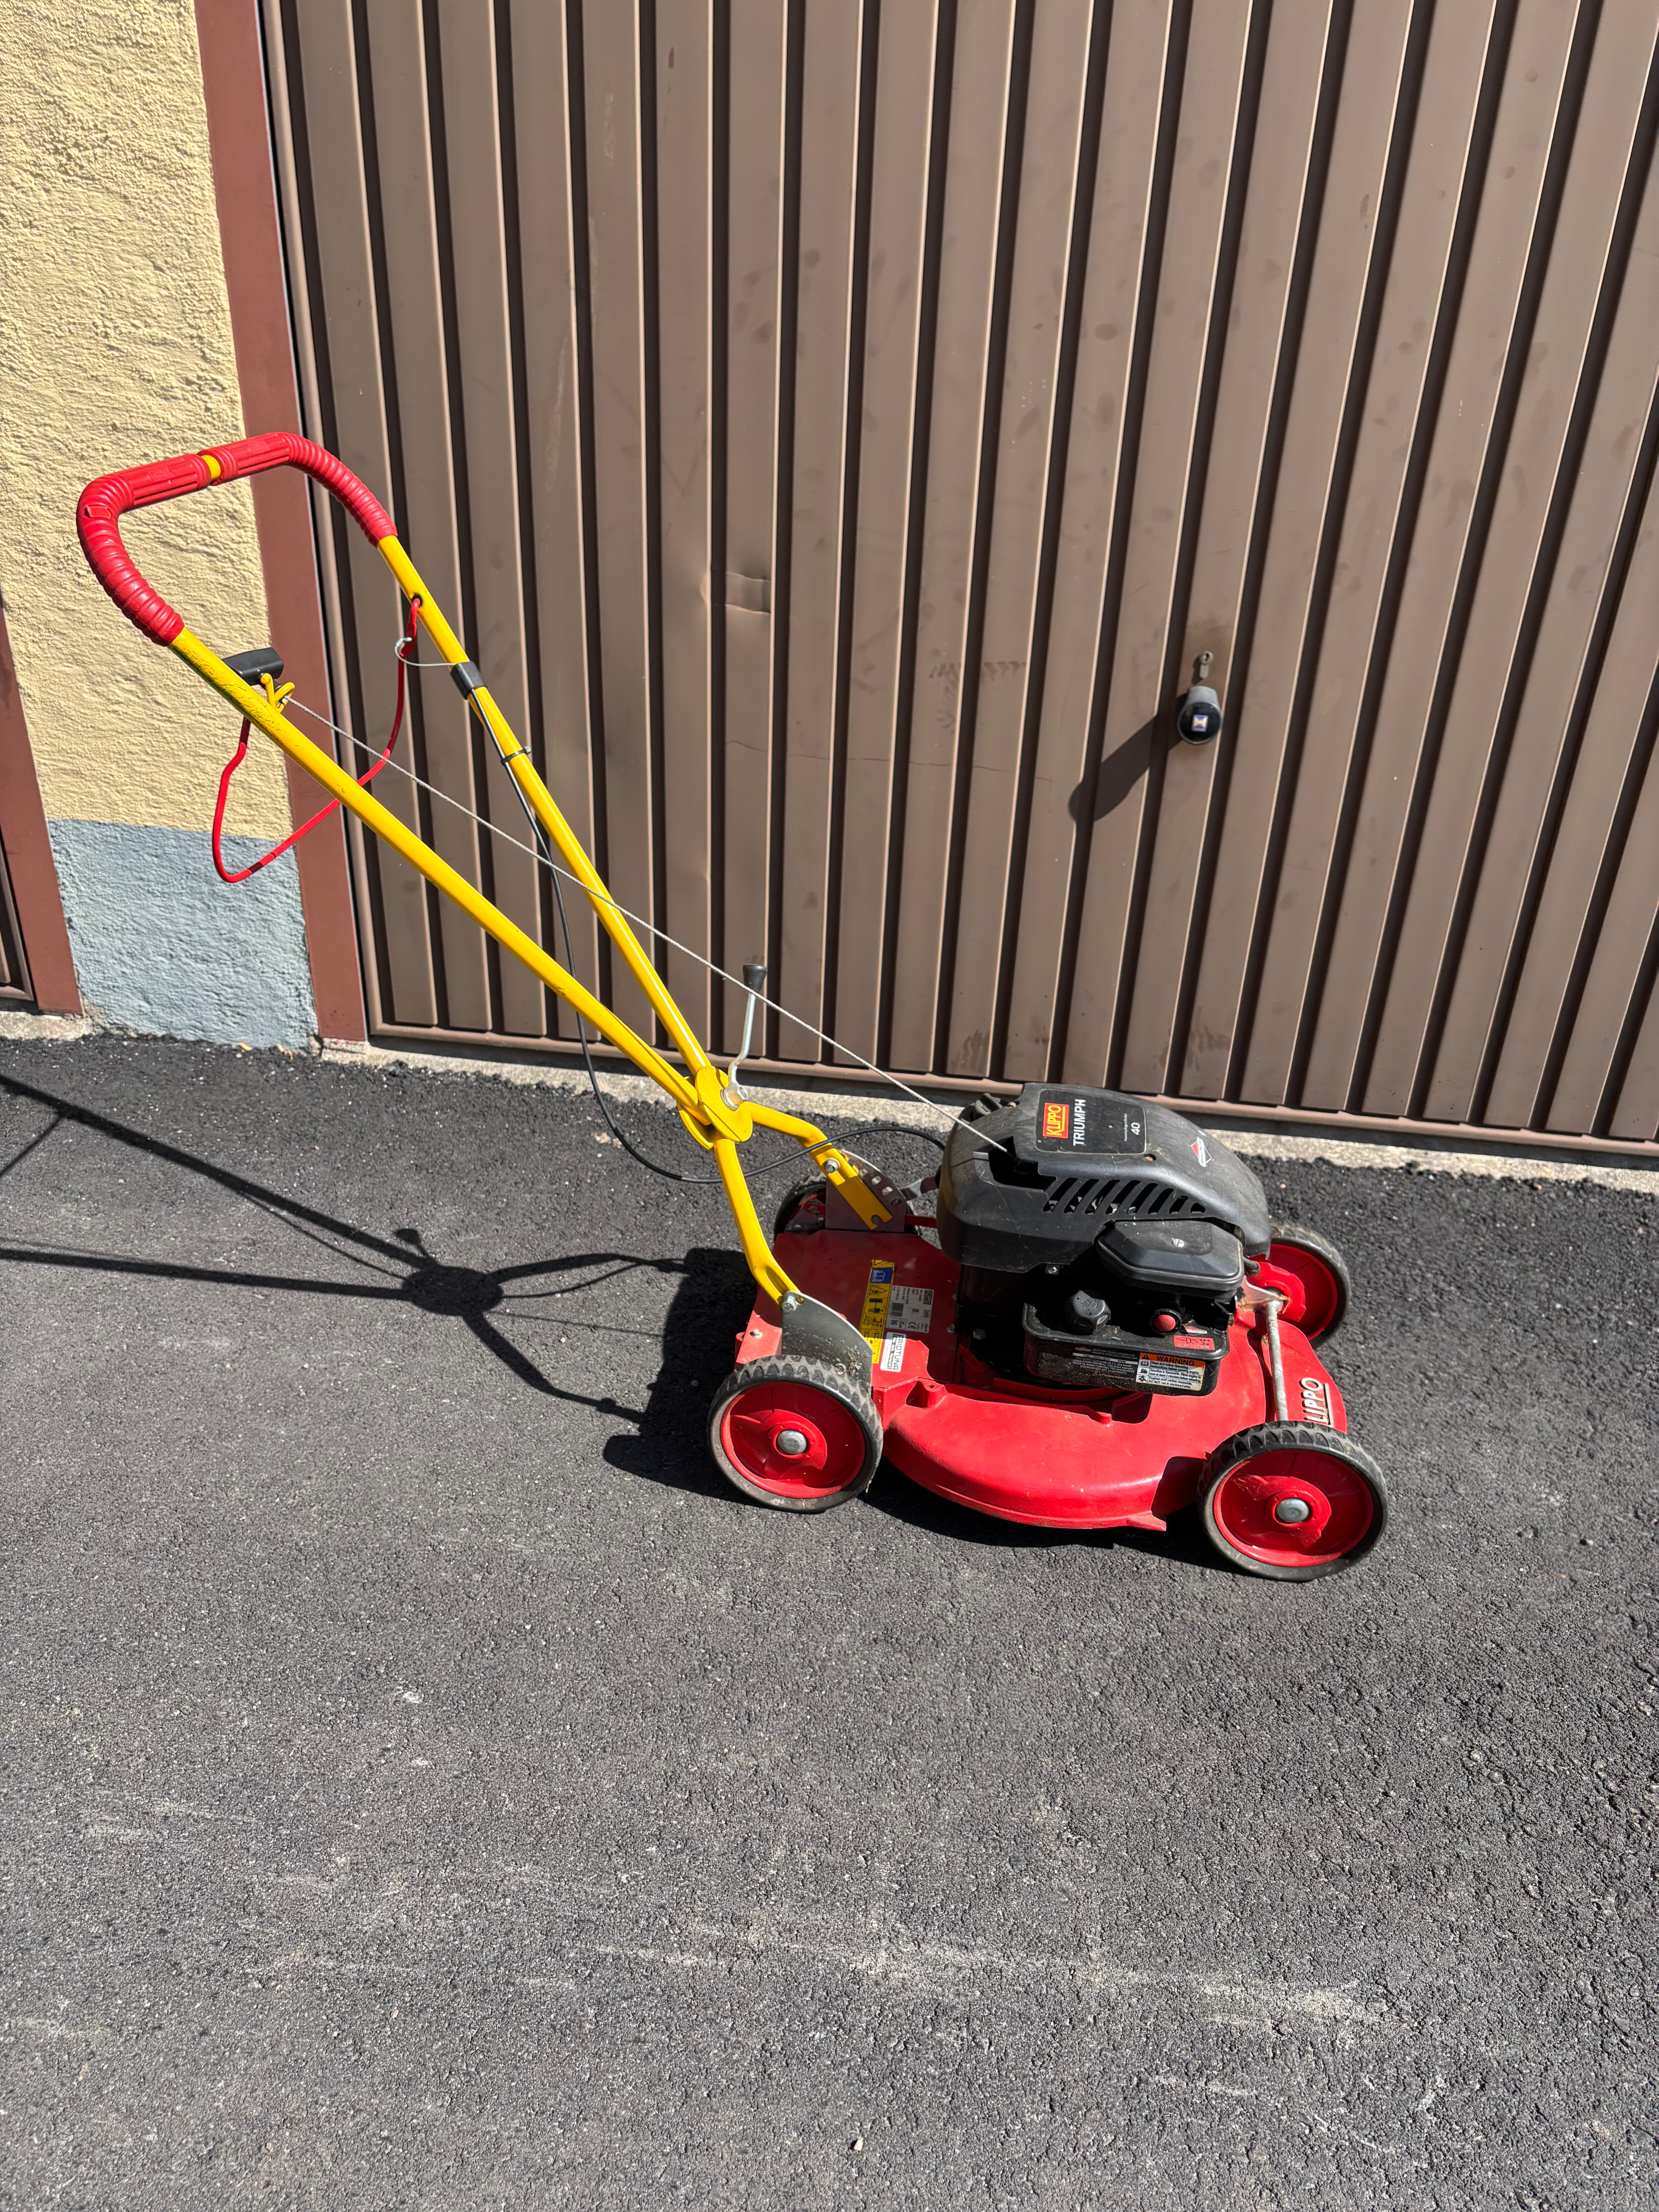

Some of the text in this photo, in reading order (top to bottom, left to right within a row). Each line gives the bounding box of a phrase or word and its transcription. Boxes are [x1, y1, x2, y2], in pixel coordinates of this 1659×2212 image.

[1046, 1105, 1066, 1136] KLIPPO
[1073, 1099, 1086, 1146] TRIUMPH
[1131, 1122, 1140, 1135] 40
[1157, 1355, 1195, 1366] WARNING
[1300, 1377, 1329, 1424] LIPPO
